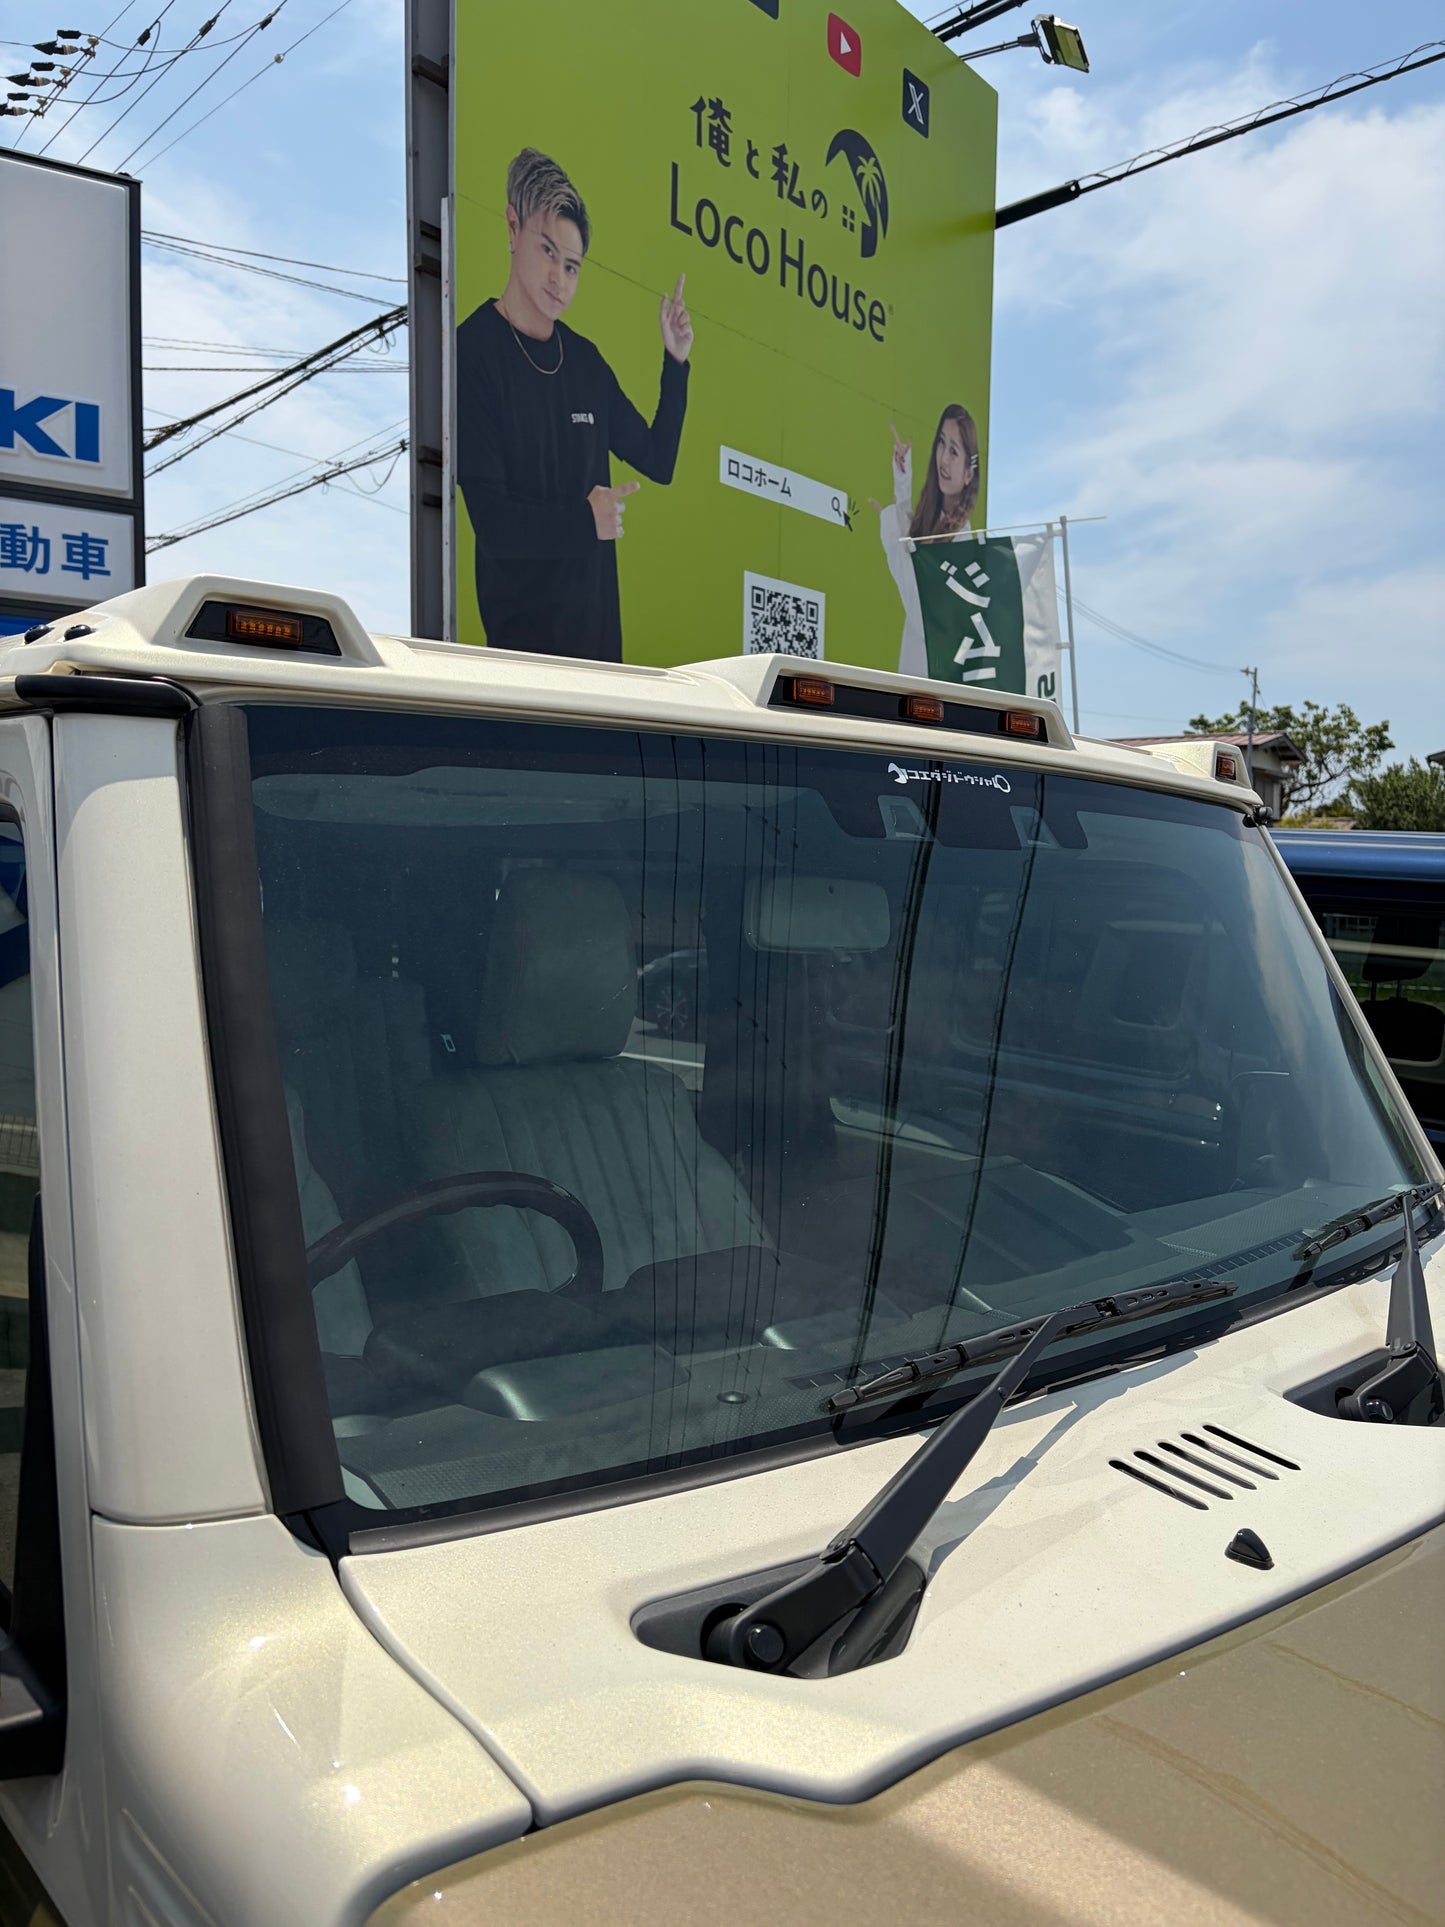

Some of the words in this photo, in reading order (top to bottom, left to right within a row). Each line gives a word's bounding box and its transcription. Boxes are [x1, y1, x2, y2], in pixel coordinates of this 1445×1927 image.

[689, 95, 828, 219] 俺と私の
[0, 388, 100, 463] KI
[728, 458, 792, 497] ロコホーム
[0, 523, 111, 580] 動車
